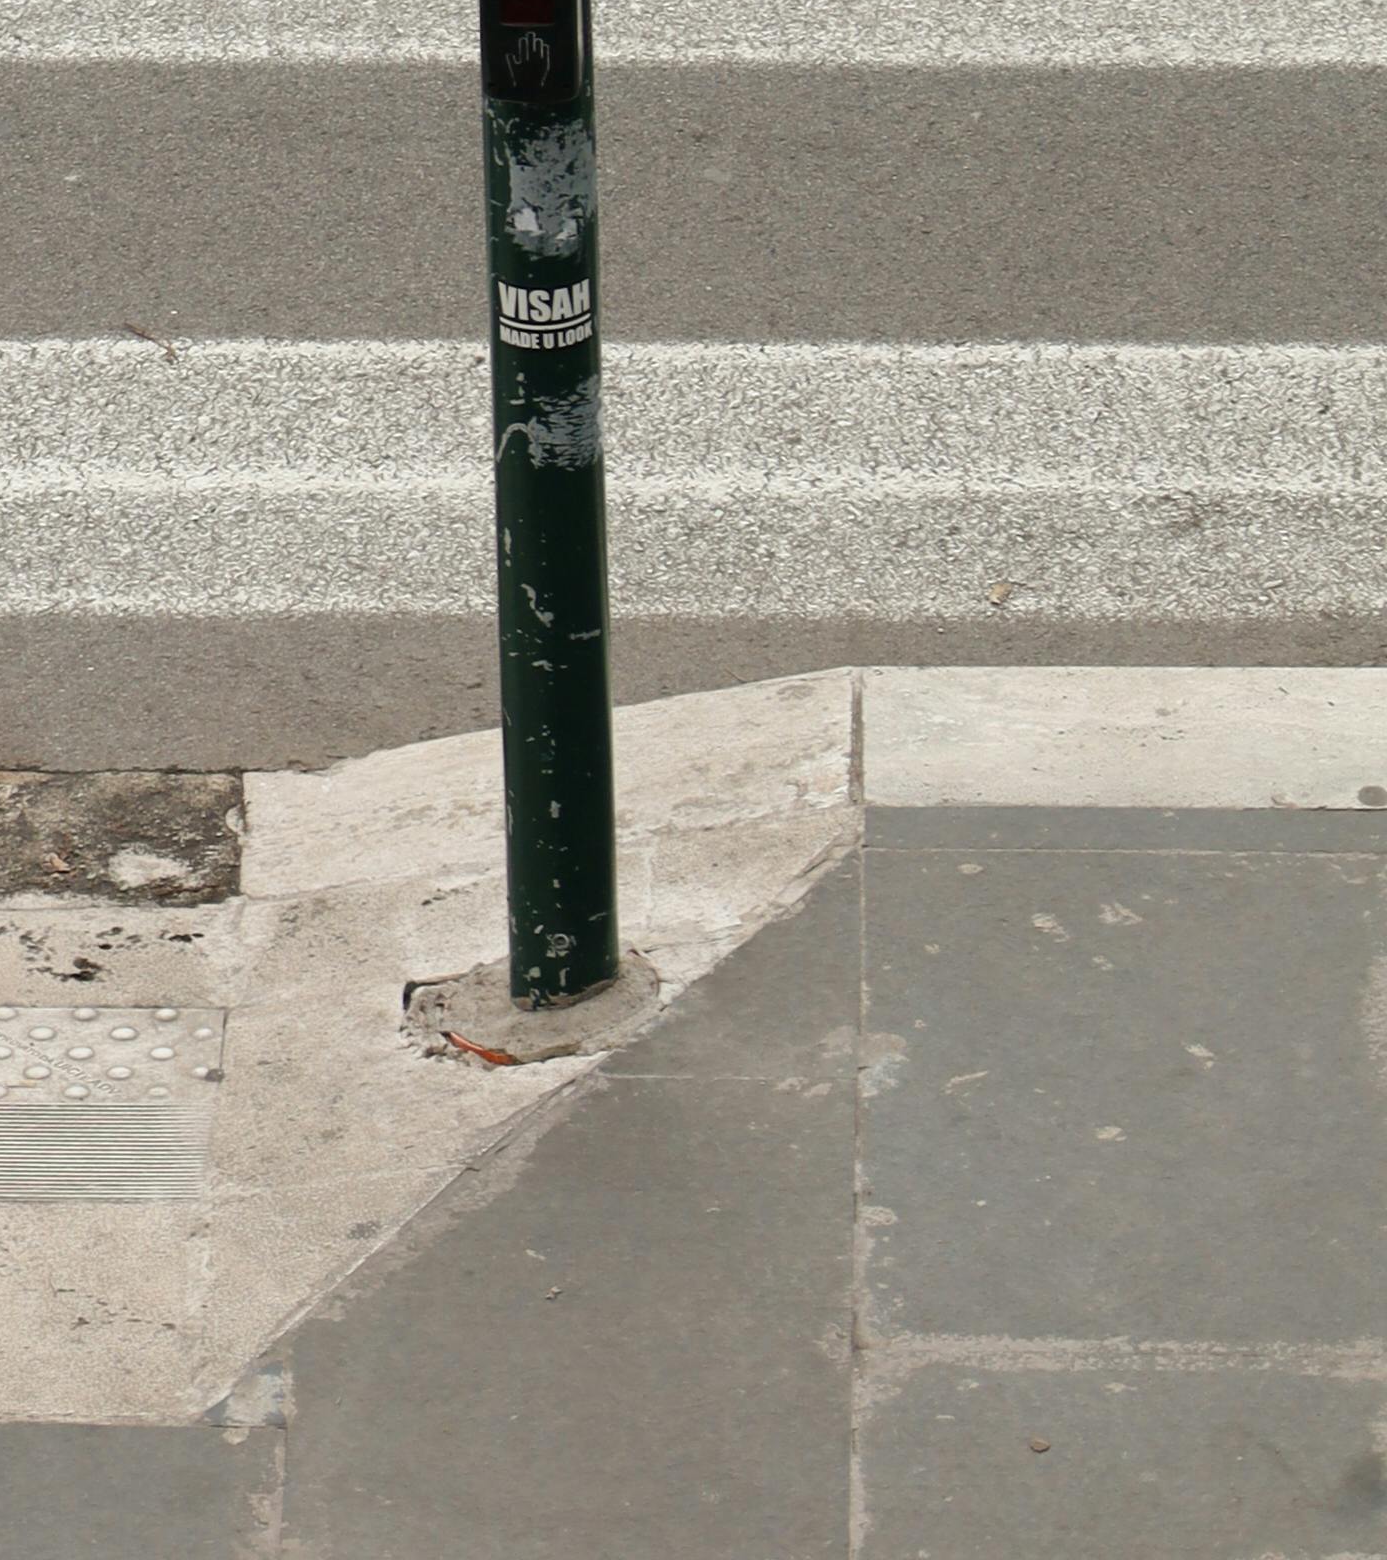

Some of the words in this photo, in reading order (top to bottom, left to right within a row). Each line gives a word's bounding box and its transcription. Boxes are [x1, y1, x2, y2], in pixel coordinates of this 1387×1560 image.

[498, 278, 590, 323] VISAH
[499, 325, 540, 349] MADE
[543, 326, 555, 349] U
[558, 320, 593, 348] LOOK
